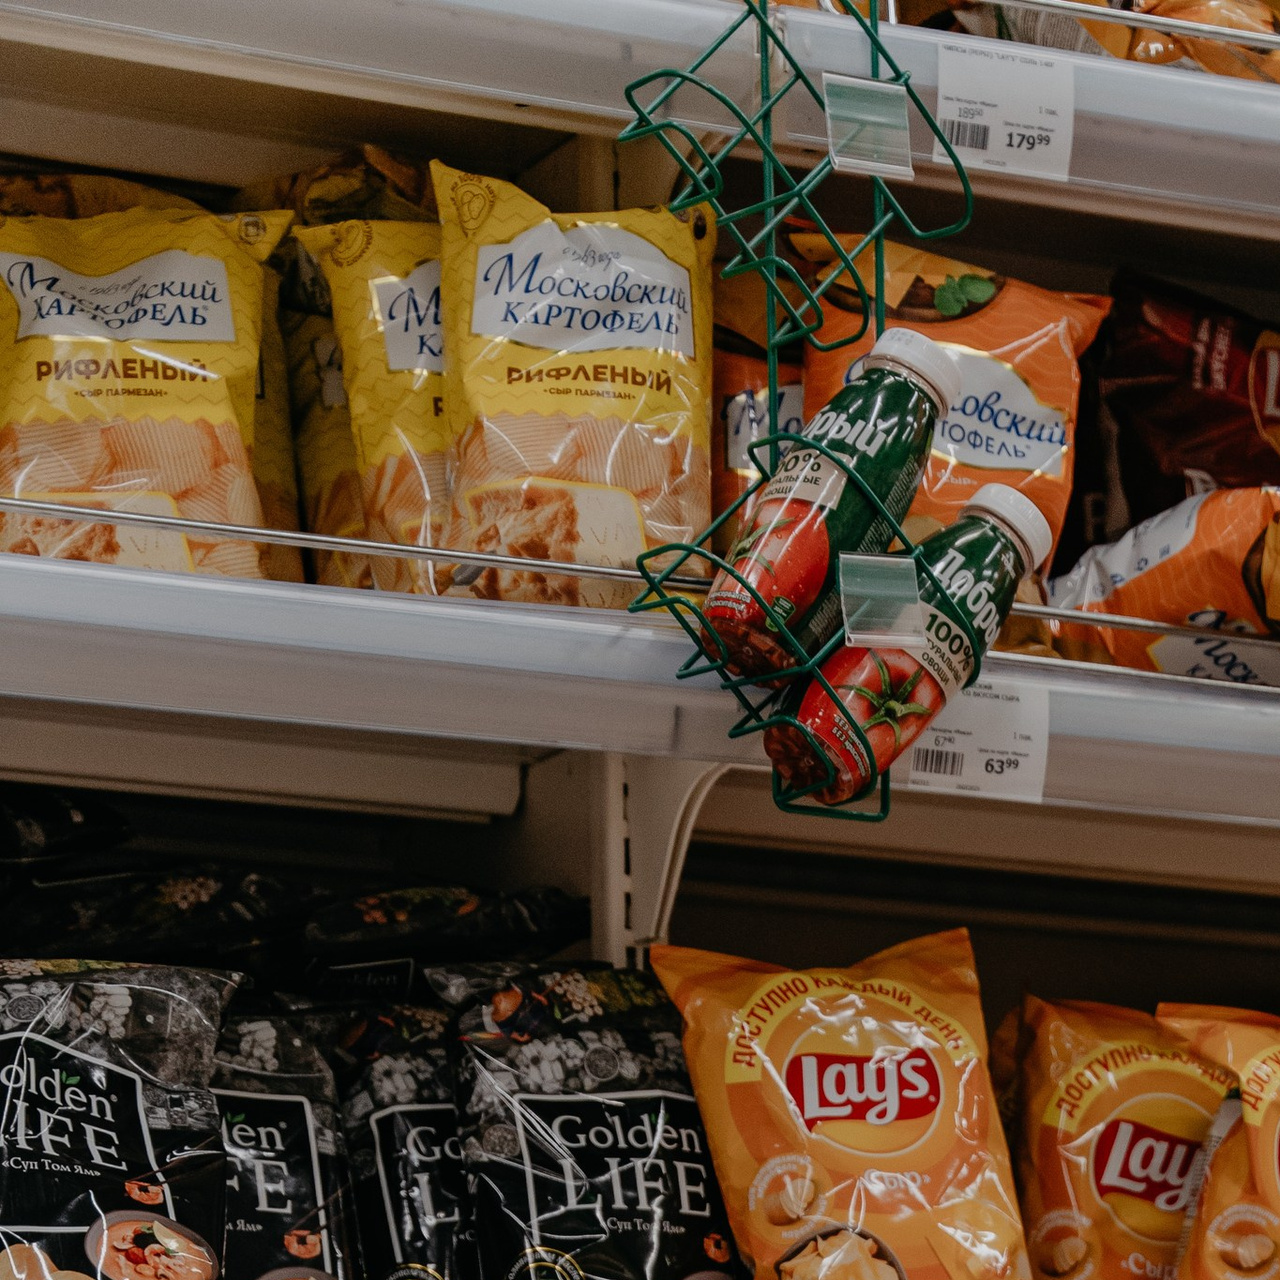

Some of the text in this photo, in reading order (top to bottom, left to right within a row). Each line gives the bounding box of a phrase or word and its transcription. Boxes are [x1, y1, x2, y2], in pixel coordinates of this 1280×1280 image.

[483, 252, 690, 315] Московский
[500, 301, 682, 337] КАРТОФЕЛЬ
[36, 359, 209, 383] РИФЛЕНЫЙ
[506, 364, 673, 396] РИФЛЕНЫЙ
[937, 422, 1029, 460] ТОФЕЛЬ
[925, 613, 973, 672] 100%
[985, 757, 1020, 775] 6399
[1, 1057, 116, 1123] olden
[12, 1099, 128, 1172] IFE
[41, 1159, 71, 1173] Том
[557, 1157, 711, 1218] LIFE
[1101, 1118, 1201, 1210] Lay
